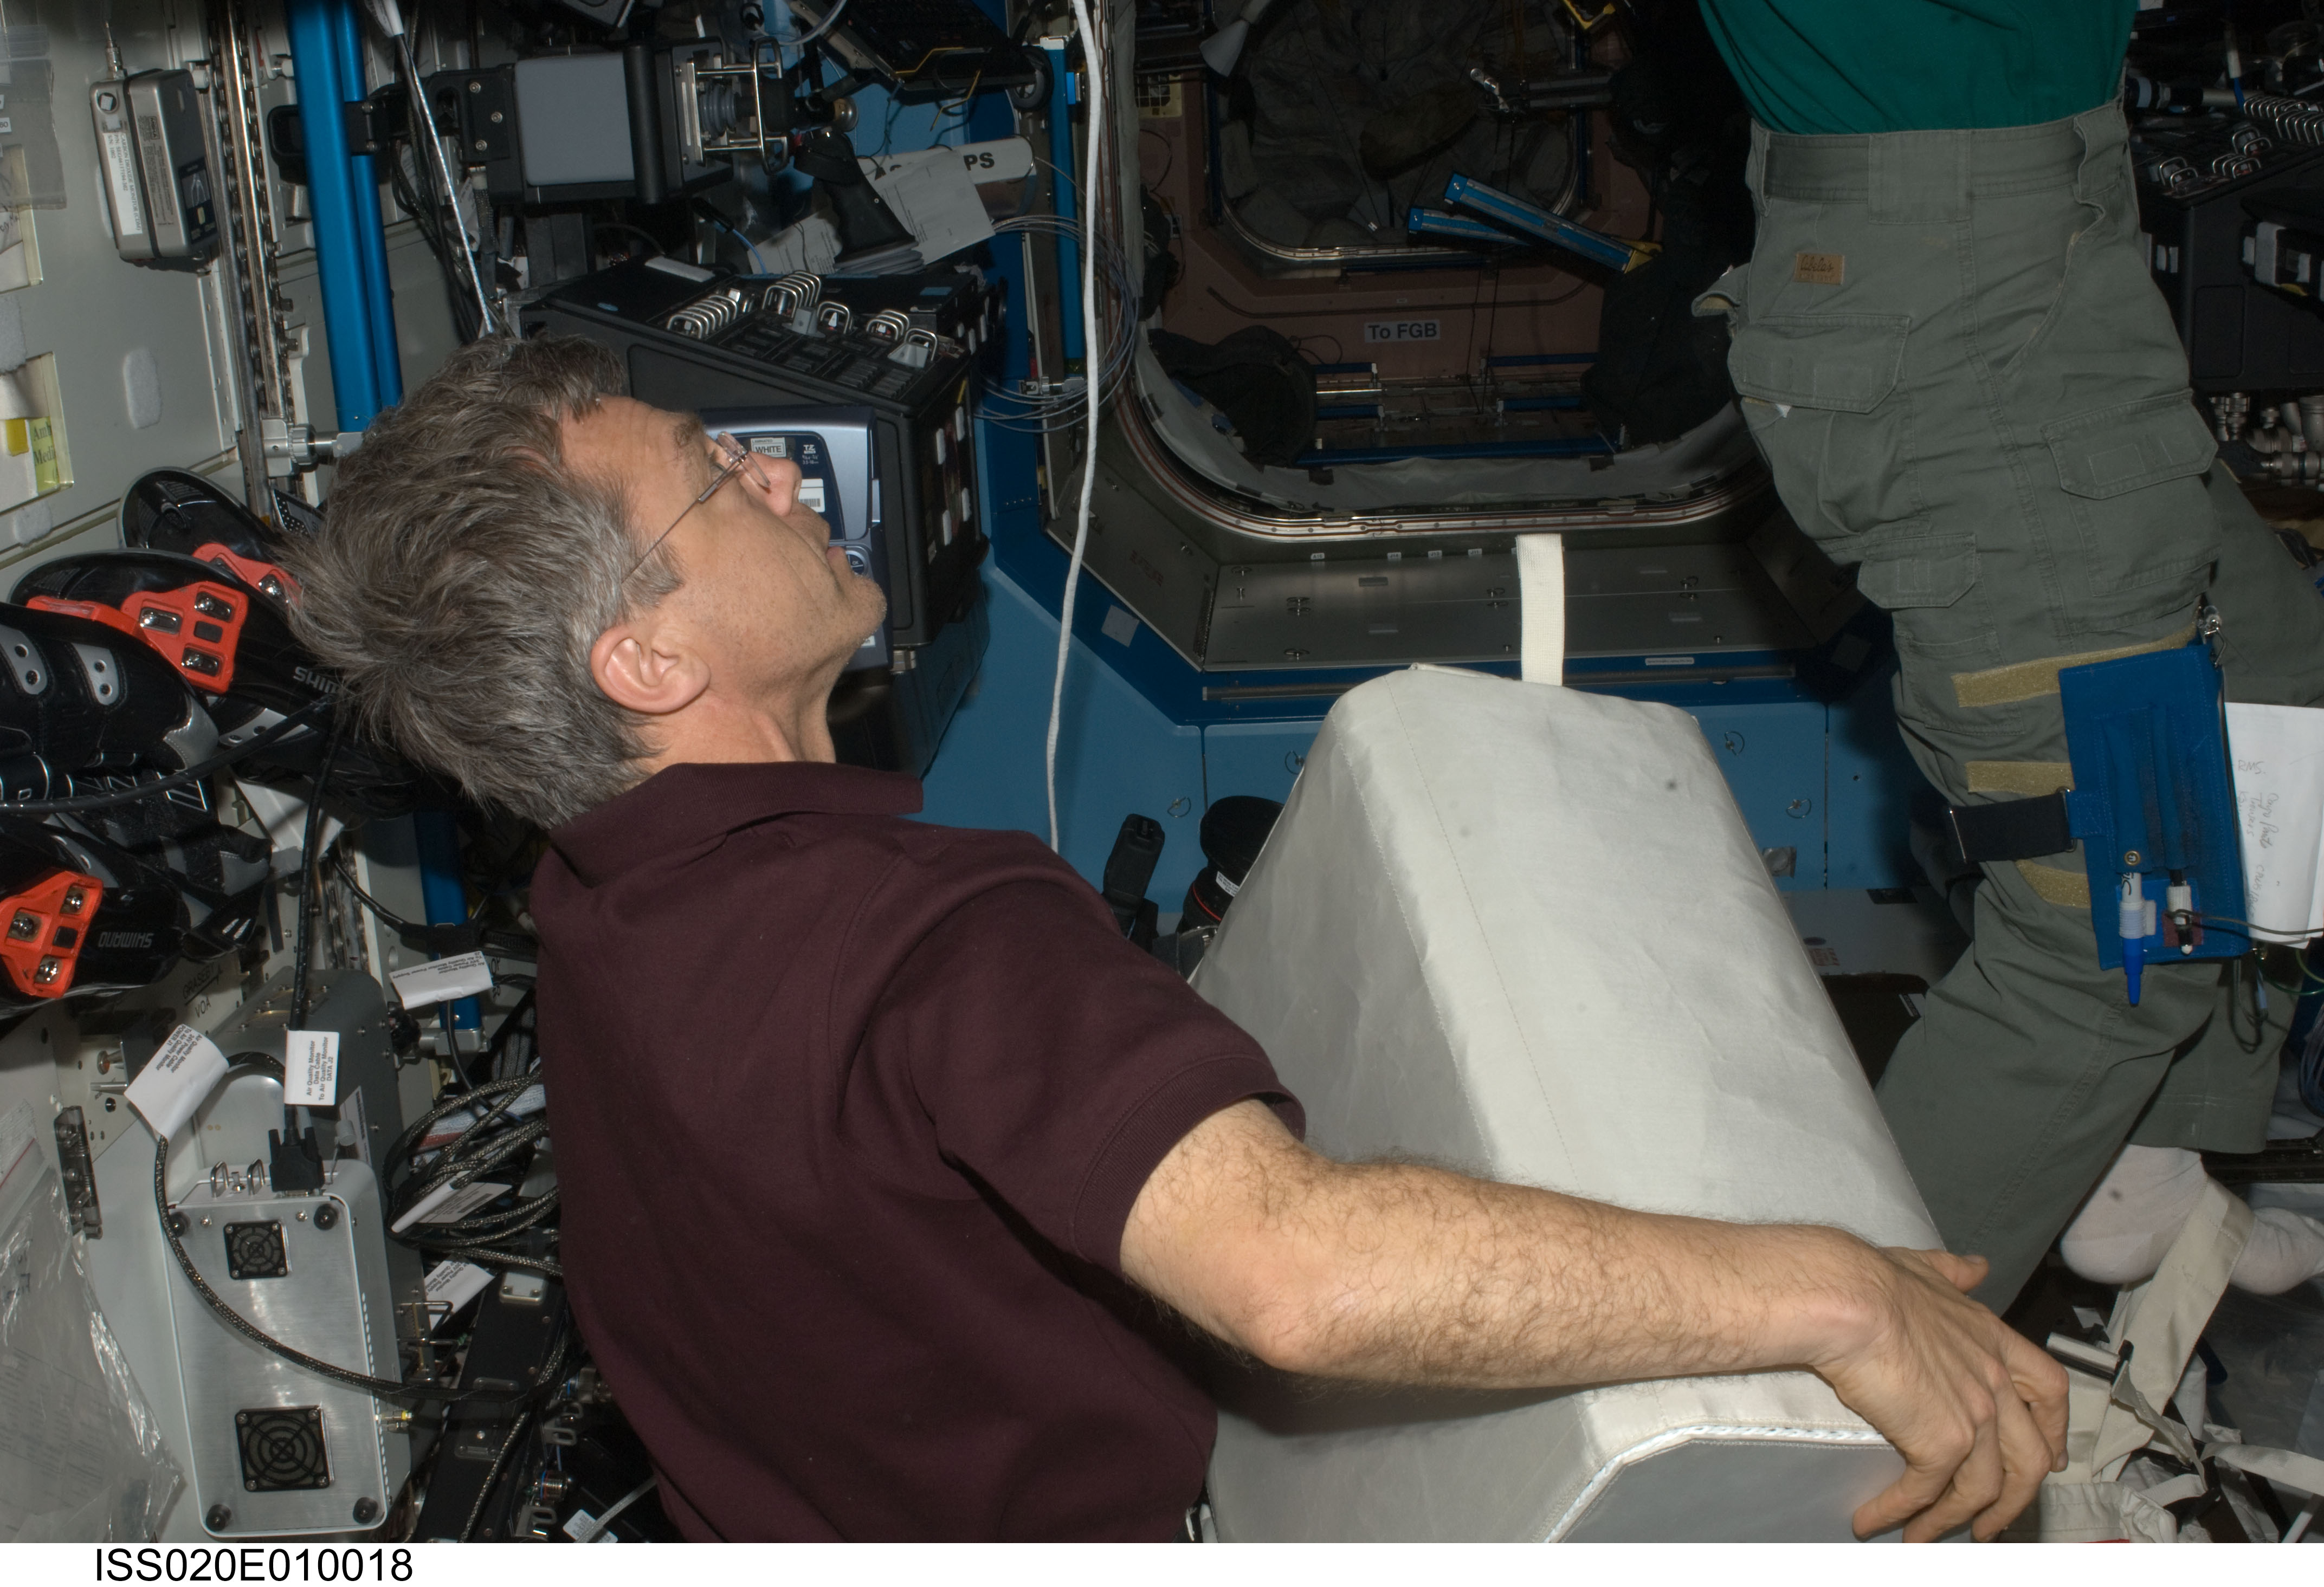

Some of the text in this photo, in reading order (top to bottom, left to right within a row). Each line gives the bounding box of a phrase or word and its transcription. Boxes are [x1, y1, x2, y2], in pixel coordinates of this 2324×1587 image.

[125, 159, 133, 184] DIOXIDE
[130, 185, 138, 212] MONITOR
[1368, 322, 1437, 340] To FGB
[98, 931, 154, 948] SHIMANO
[195, 996, 212, 1019] VOA
[171, 1024, 186, 1041] POWER
[167, 1039, 182, 1055] Quality
[176, 1042, 188, 1056] Power
[183, 1040, 197, 1057] Quality
[155, 1053, 170, 1071] Monitor
[165, 1054, 178, 1068] Cable
[170, 1055, 185, 1073] Monitor
[328, 1056, 333, 1064] J2
